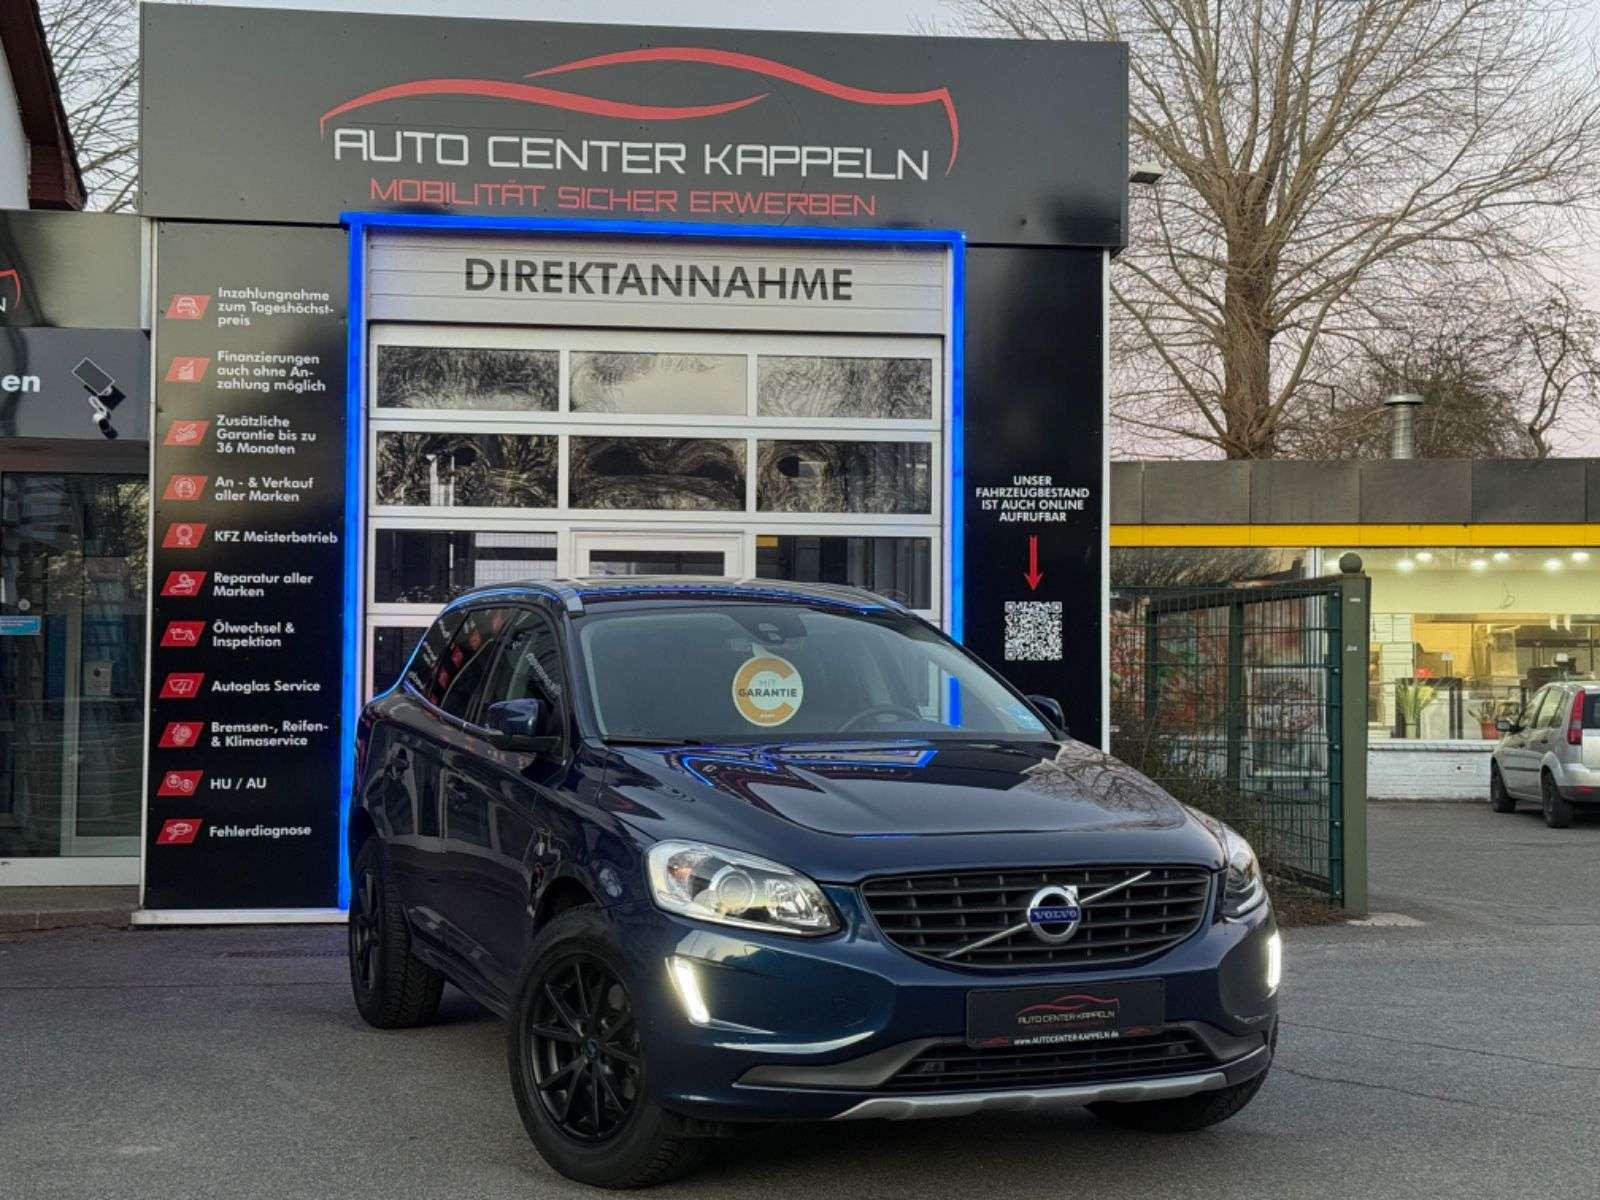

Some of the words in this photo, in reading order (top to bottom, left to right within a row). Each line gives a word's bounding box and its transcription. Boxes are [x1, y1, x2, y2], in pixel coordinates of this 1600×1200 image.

[334, 128, 469, 166] AUTO
[488, 136, 687, 174] CENTER
[703, 144, 928, 181] KAPPELN
[369, 177, 546, 208] MOBILITÄT
[558, 186, 678, 213] SICHER
[689, 190, 876, 217] ERWERBEN
[465, 258, 852, 301] DIREKTANNAHME
[218, 287, 330, 304] Inzahlungnahme
[218, 303, 246, 312] zum
[250, 301, 334, 316] Tageshöchst-
[218, 314, 250, 328] preis
[217, 350, 320, 366] Finanzierungen
[216, 365, 249, 377] auch
[253, 366, 287, 378] ohne
[290, 367, 314, 378] An-
[1, 374, 41, 393] en
[216, 379, 270, 392] zahlung
[274, 380, 327, 394] möglich
[216, 414, 290, 428] Zusätzliche
[216, 428, 275, 441] Garantie
[278, 429, 297, 442] bis
[301, 432, 316, 442] zu
[216, 442, 233, 454] 36
[237, 442, 296, 455] Monaten
[215, 476, 234, 488] An
[248, 477, 258, 488] &
[261, 477, 314, 490] Verkauf
[1013, 475, 1052, 486] UNSER
[214, 490, 246, 502] aller
[249, 491, 300, 503] Marken
[975, 487, 1090, 498] FAHRZEUGBESTAND
[982, 499, 998, 510] IST
[1001, 499, 1036, 510] AUCH
[1039, 499, 1084, 510] ONLINE
[999, 511, 1067, 522] AUFRUFBAR
[214, 530, 240, 543] KFZ
[243, 531, 338, 544] Meisterbetrieb
[213, 571, 280, 585] Reparatur
[283, 572, 314, 584] aller
[213, 585, 264, 597] Marken
[212, 619, 281, 634] Ölwechsel
[285, 622, 295, 634] &
[212, 636, 282, 649] Inspektion
[211, 680, 271, 694] Autoglas
[274, 680, 321, 692] Service
[738, 688, 798, 697] GARANTIE
[211, 721, 278, 734] Bremsen-,
[282, 719, 329, 732] Reifen-
[211, 736, 221, 747] &
[225, 735, 308, 747] Klimaservice
[210, 778, 232, 790] HU
[246, 778, 267, 789] AU
[209, 825, 312, 839] Fehlerdiagnose
[1033, 909, 1077, 920] VOLVO
[1017, 1015, 1042, 1024] AUTO
[1042, 1012, 1075, 1023] CENTER
[1076, 1010, 1115, 1020] KAPPELN
